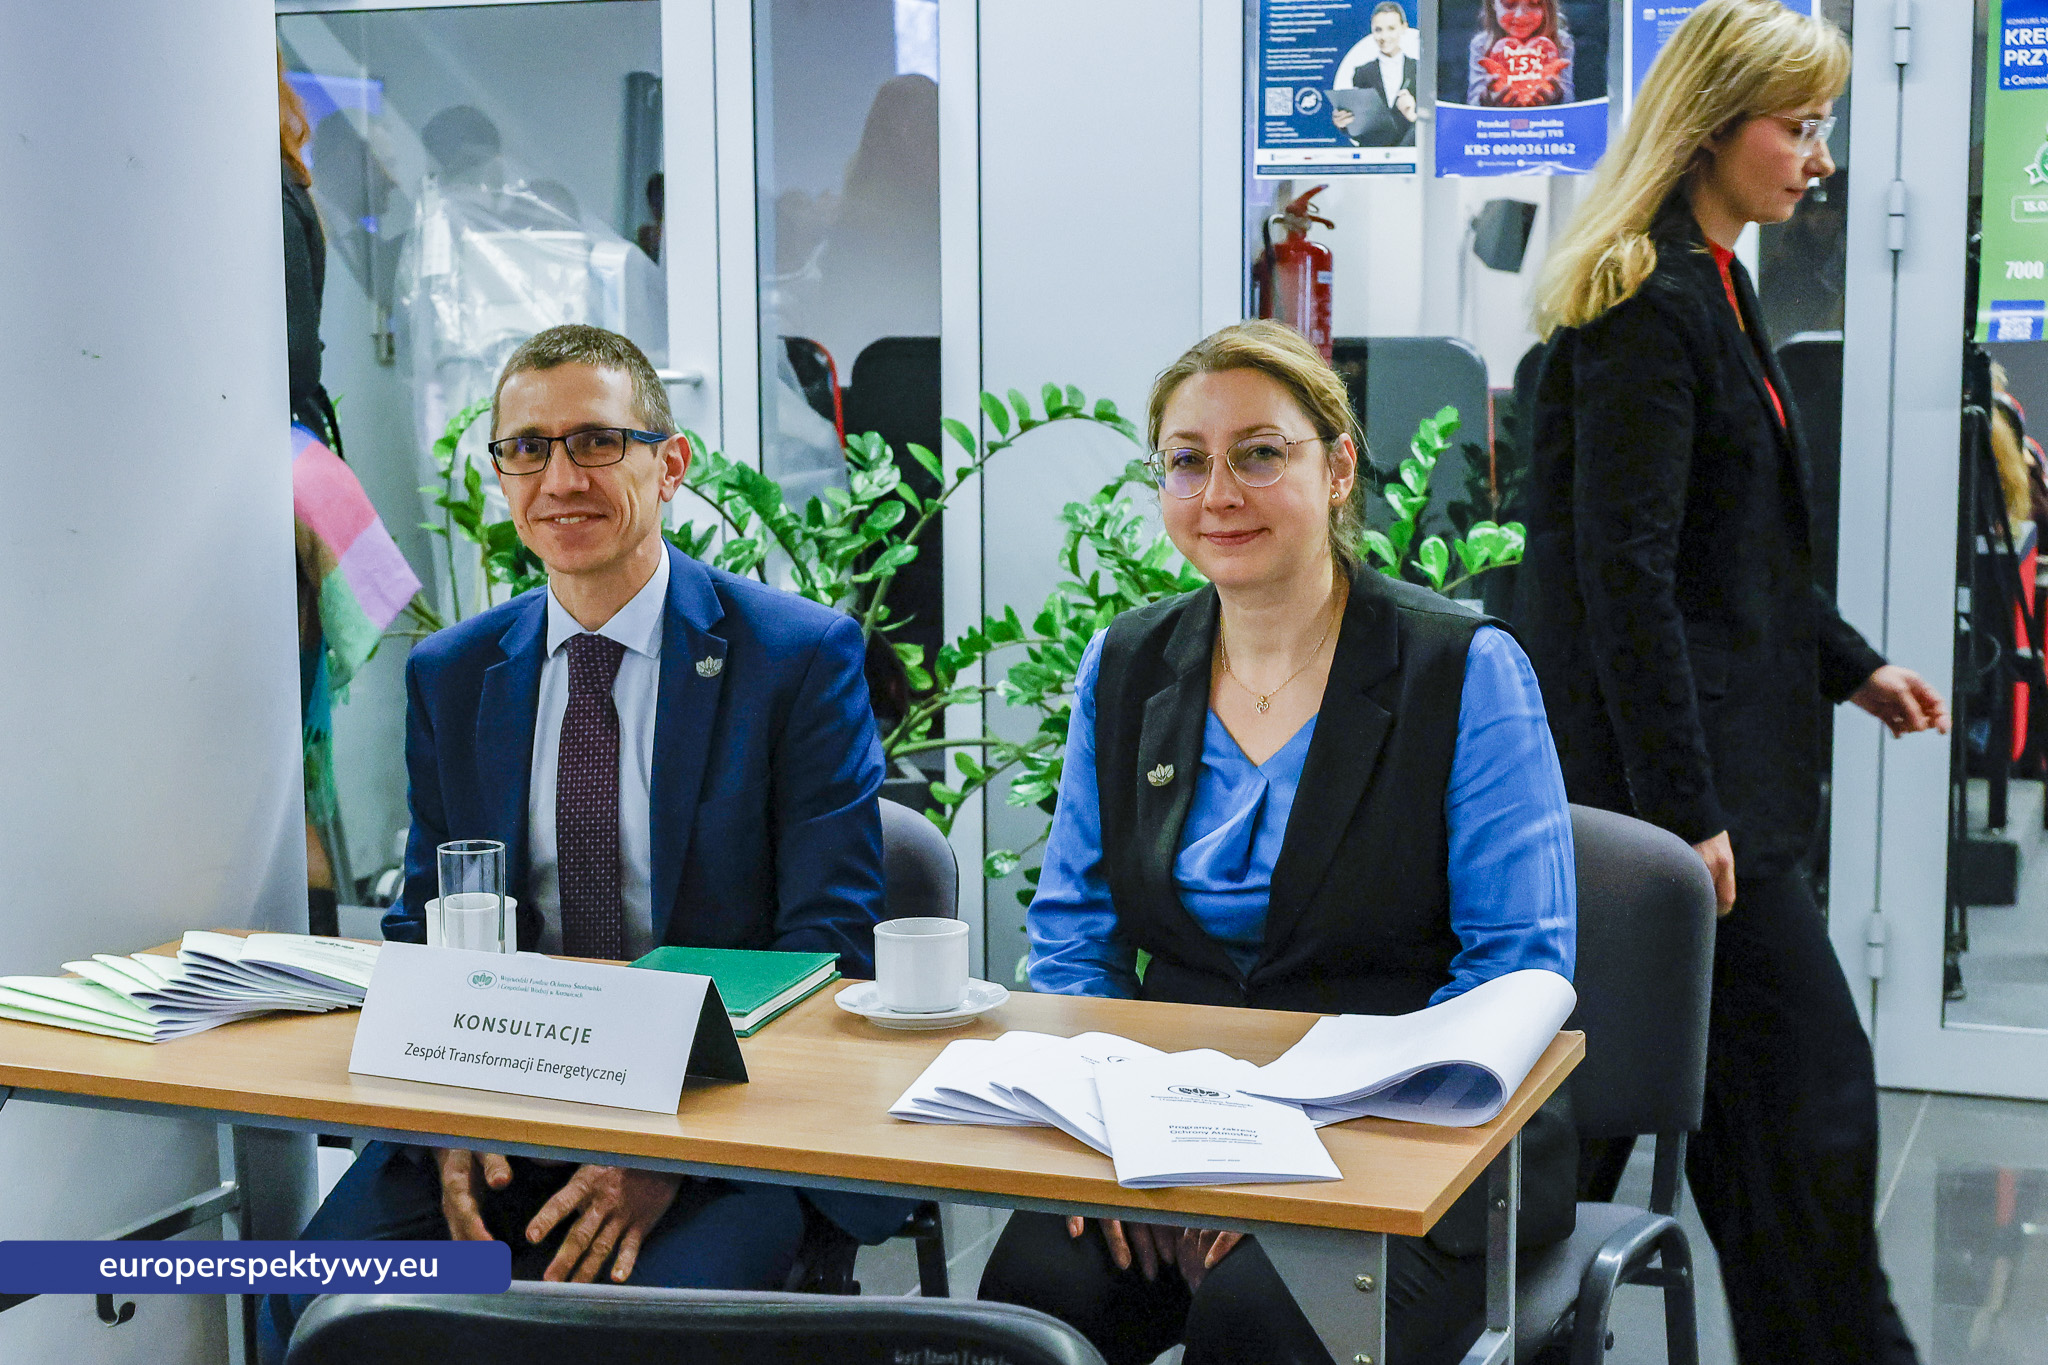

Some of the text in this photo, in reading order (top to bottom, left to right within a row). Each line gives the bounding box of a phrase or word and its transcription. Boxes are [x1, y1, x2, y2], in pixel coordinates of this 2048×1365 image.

[2005, 28, 2048, 46] KRE
[1464, 144, 1491, 156] KRS
[2005, 260, 2045, 280] 7000
[453, 1013, 592, 1045] KONSULTACJE
[404, 1041, 628, 1085] Zespół Transformacji Energetycznej
